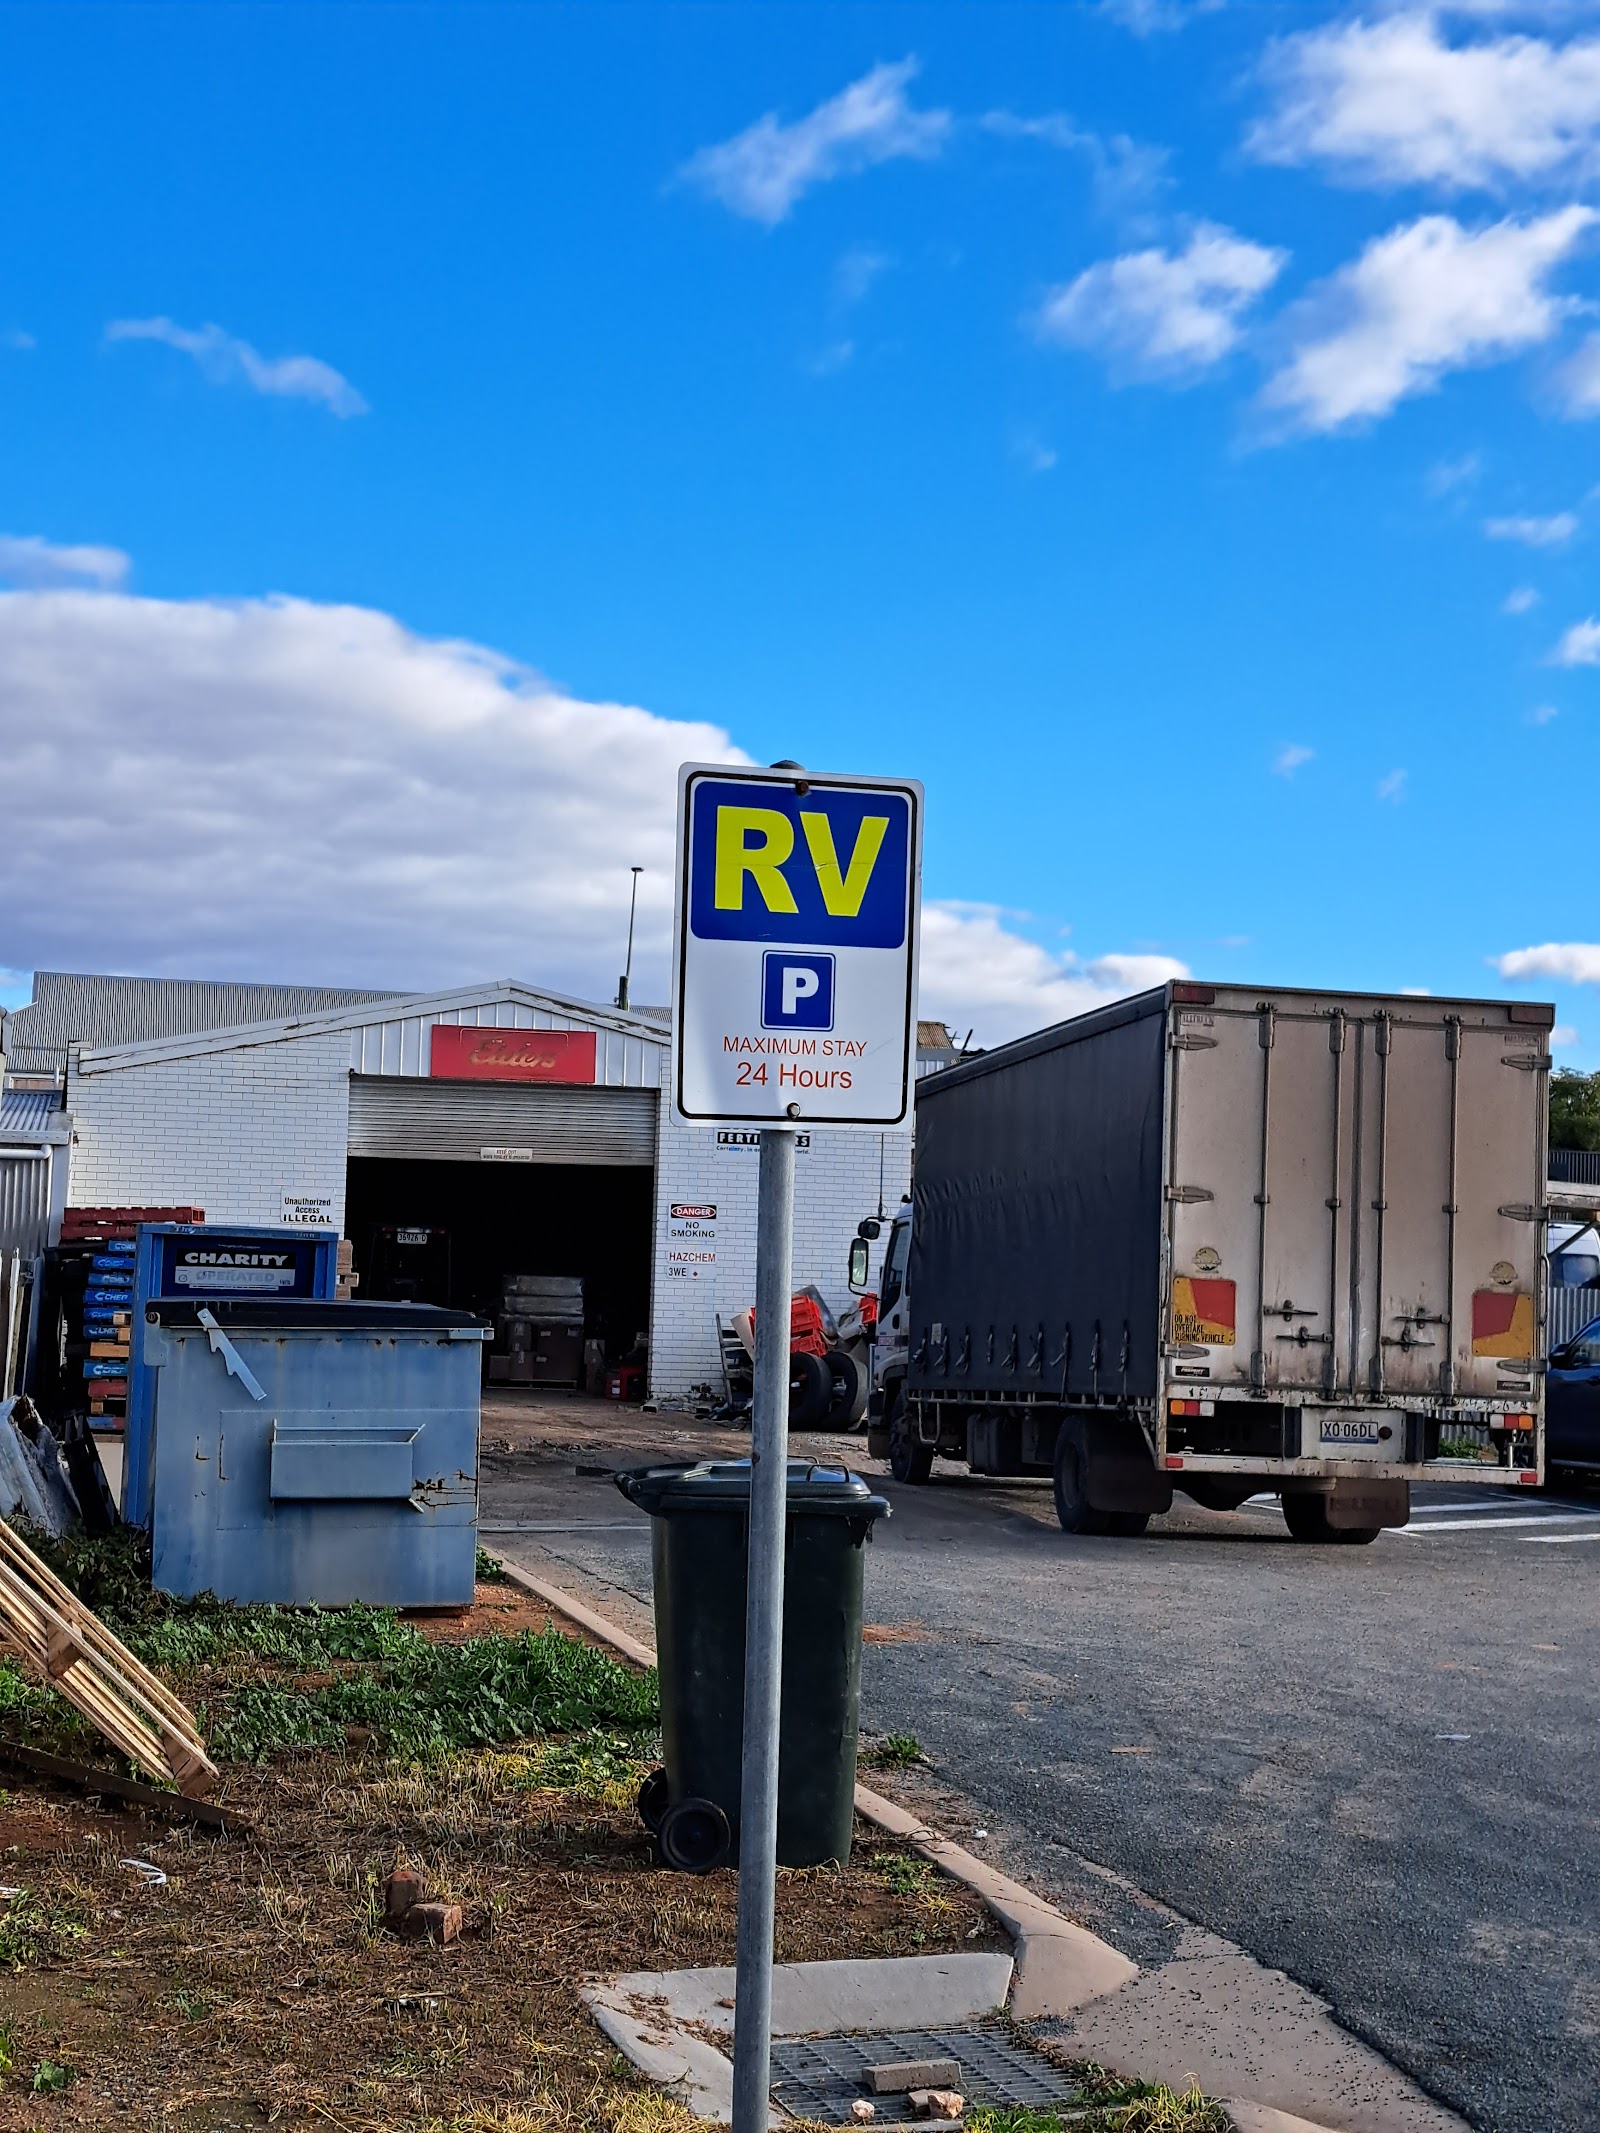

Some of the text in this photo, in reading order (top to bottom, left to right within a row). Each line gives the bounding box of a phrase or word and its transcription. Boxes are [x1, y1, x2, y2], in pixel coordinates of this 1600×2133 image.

[715, 805, 890, 917] RV
[782, 967, 819, 1014] P
[723, 1036, 868, 1057] MAXIMUM STAY
[736, 1061, 852, 1089] 24 Hours
[284, 1197, 331, 1206] Unauthorized
[295, 1206, 320, 1214] Access
[676, 1207, 711, 1216] DANGER
[283, 1214, 333, 1223] ILLEGAL
[685, 1221, 700, 1229] NO
[671, 1229, 715, 1238] SMOKING
[184, 1252, 289, 1267] CHARITY
[669, 1252, 716, 1262] HAZCHEM
[196, 1270, 275, 1284] OPERATED
[668, 1267, 687, 1277] 3WE
[1174, 1314, 1197, 1323] DO NOT
[1174, 1323, 1204, 1333] OVERTAKE
[1201, 1334, 1225, 1344] VEHICLE
